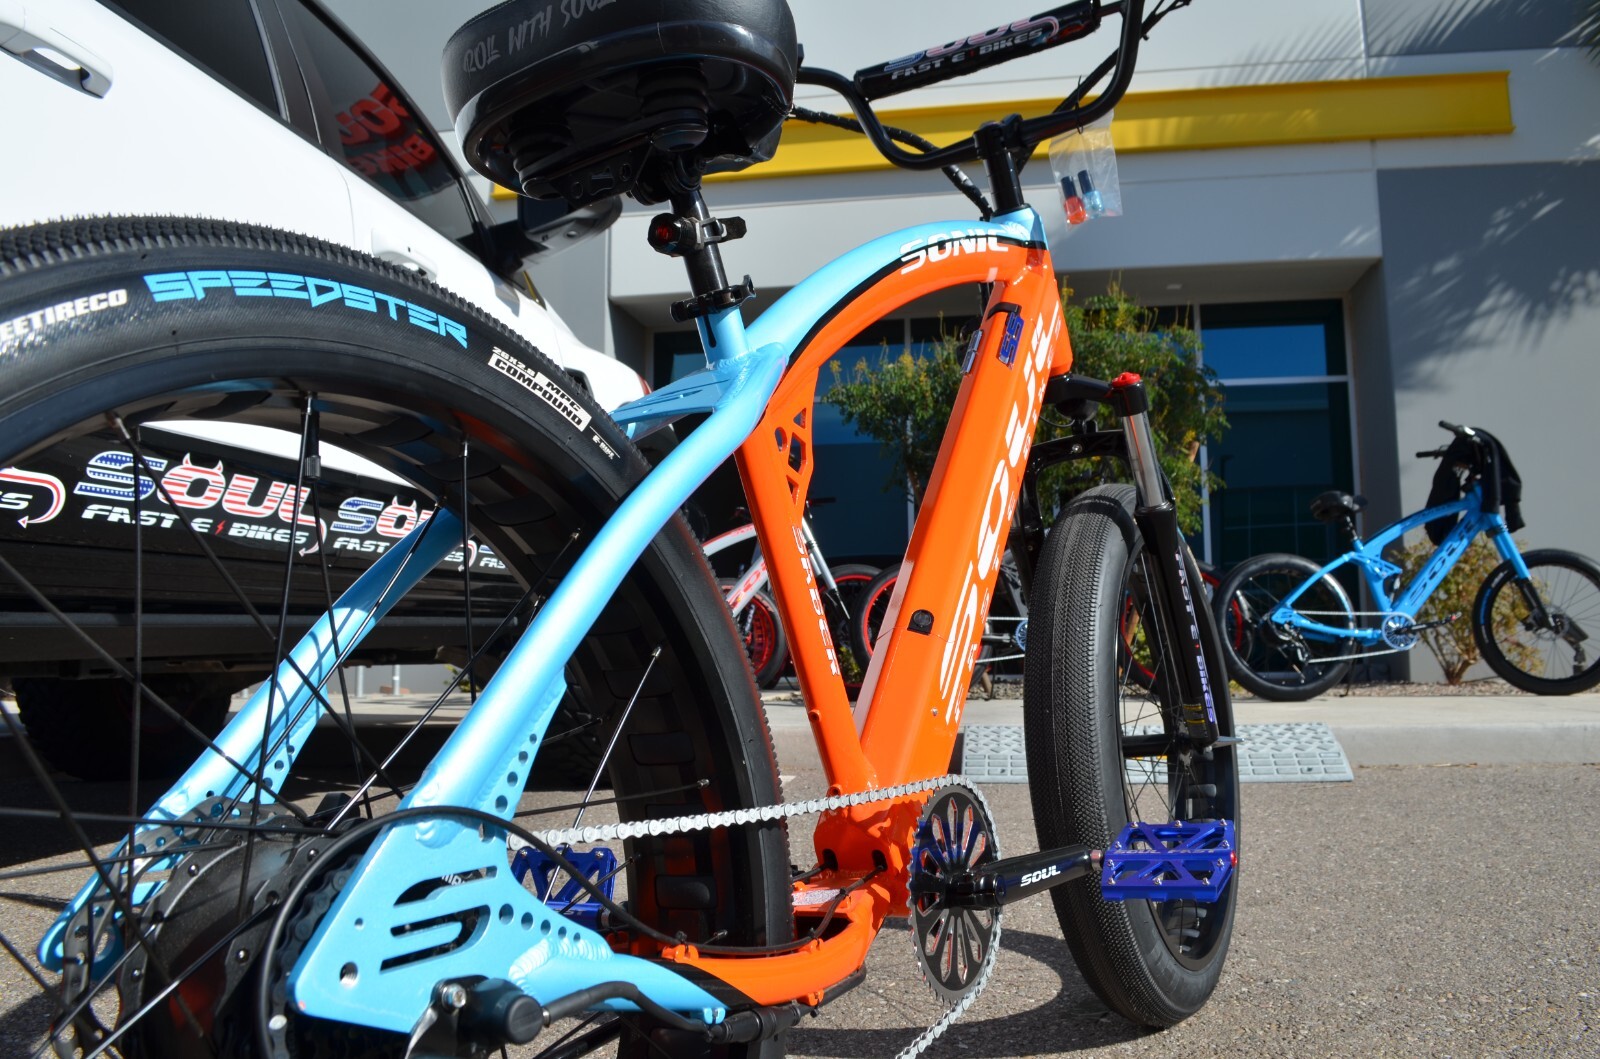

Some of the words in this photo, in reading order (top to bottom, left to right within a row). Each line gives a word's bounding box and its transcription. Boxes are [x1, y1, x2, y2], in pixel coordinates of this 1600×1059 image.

[508, 5, 553, 55] WITH
[891, 58, 945, 80] FAST
[951, 52, 966, 63] E
[978, 28, 1043, 55] BIKES
[900, 228, 1009, 275] SONIC
[143, 270, 468, 350] SPEEDSTER
[494, 357, 583, 427] COMPOUND
[546, 381, 581, 412] MPC
[73, 450, 324, 528] SOUL
[939, 300, 1060, 725] SOUL
[81, 504, 181, 528] FAST
[191, 517, 214, 533] E
[228, 522, 310, 544] BIKES
[333, 537, 391, 554] FAST
[791, 525, 841, 677] SABER
[1020, 865, 1061, 887] SOUL
